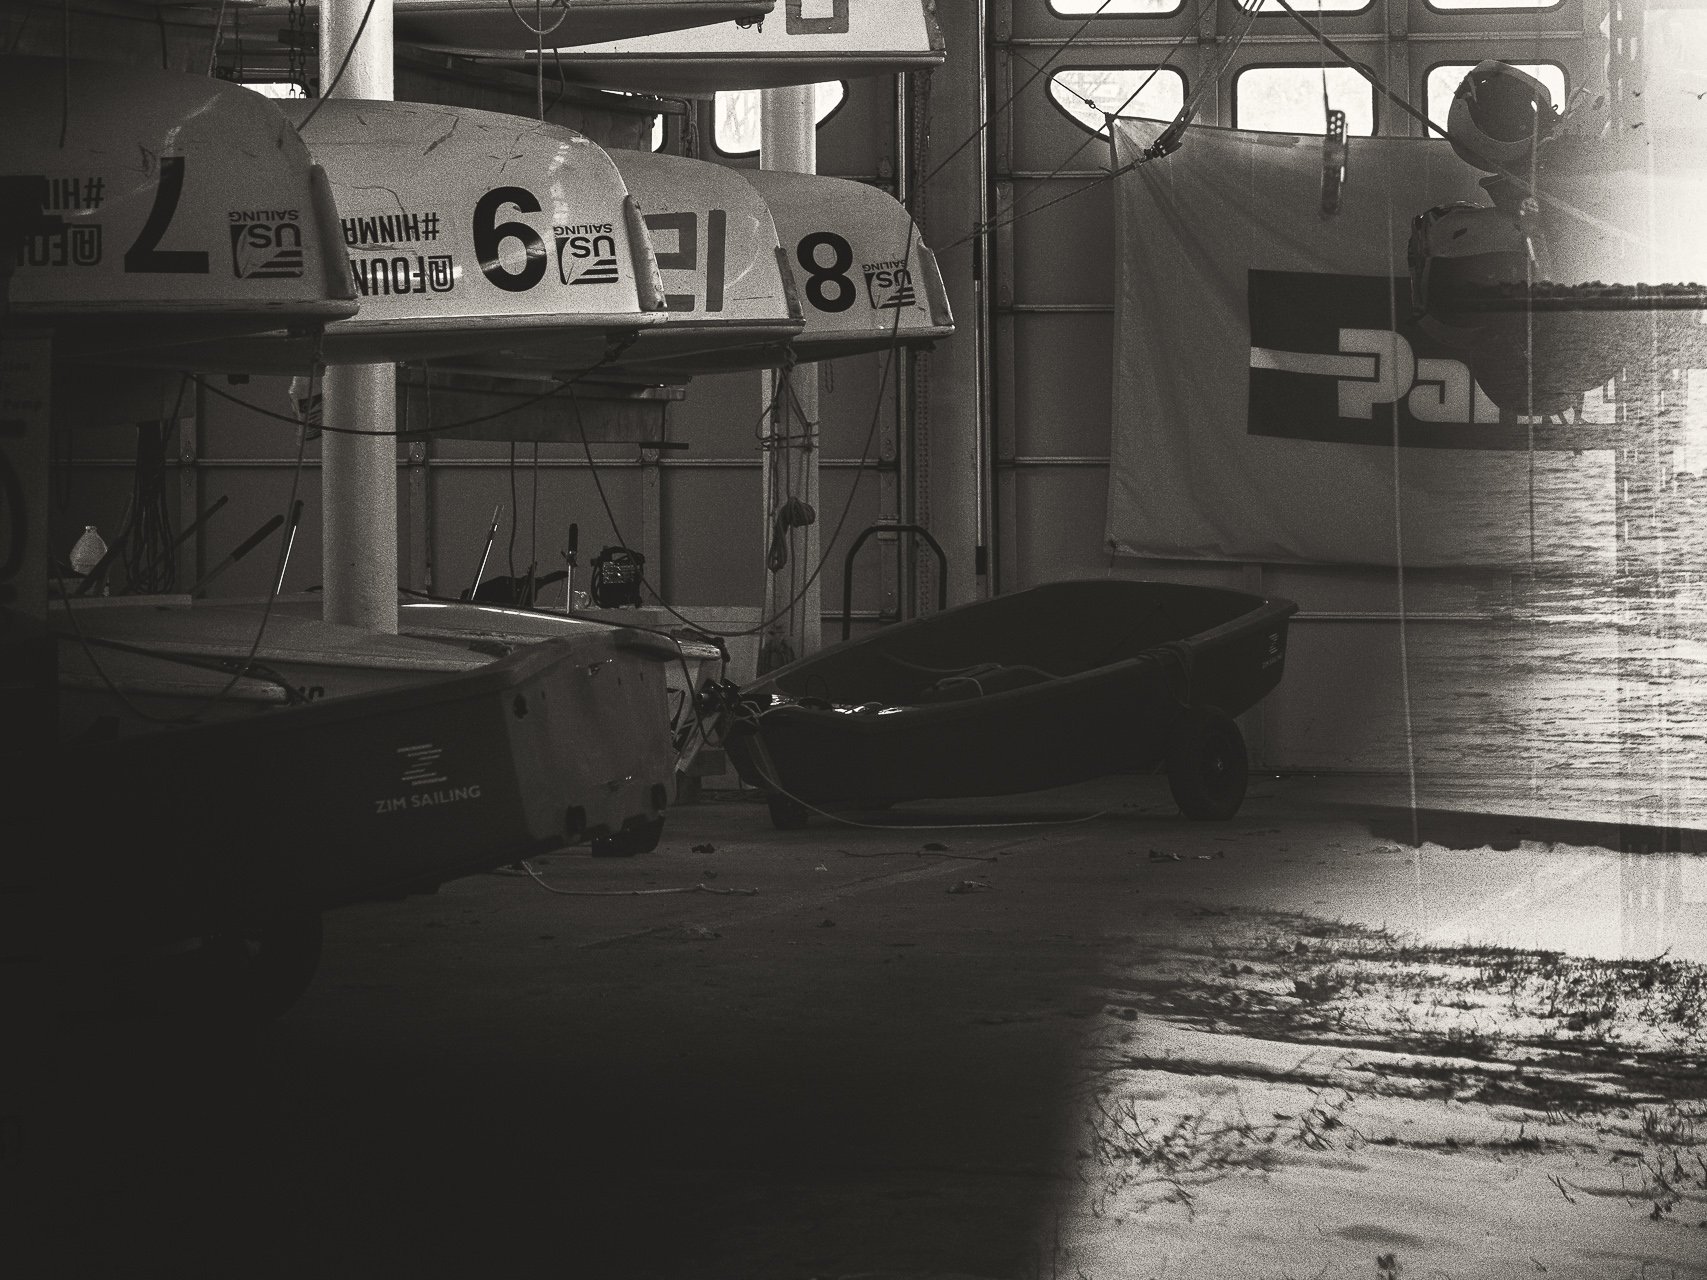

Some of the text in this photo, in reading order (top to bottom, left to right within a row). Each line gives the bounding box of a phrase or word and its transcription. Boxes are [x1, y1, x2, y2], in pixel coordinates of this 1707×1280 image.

[124, 156, 210, 274] 7
[228, 209, 299, 223] SAILING
[248, 222, 302, 249] US
[342, 212, 440, 246] #HINMA
[552, 223, 612, 237] SAILING
[569, 234, 616, 260] US
[796, 231, 857, 313] 8
[877, 268, 912, 288] US
[375, 784, 482, 814] ZIM SAILING
